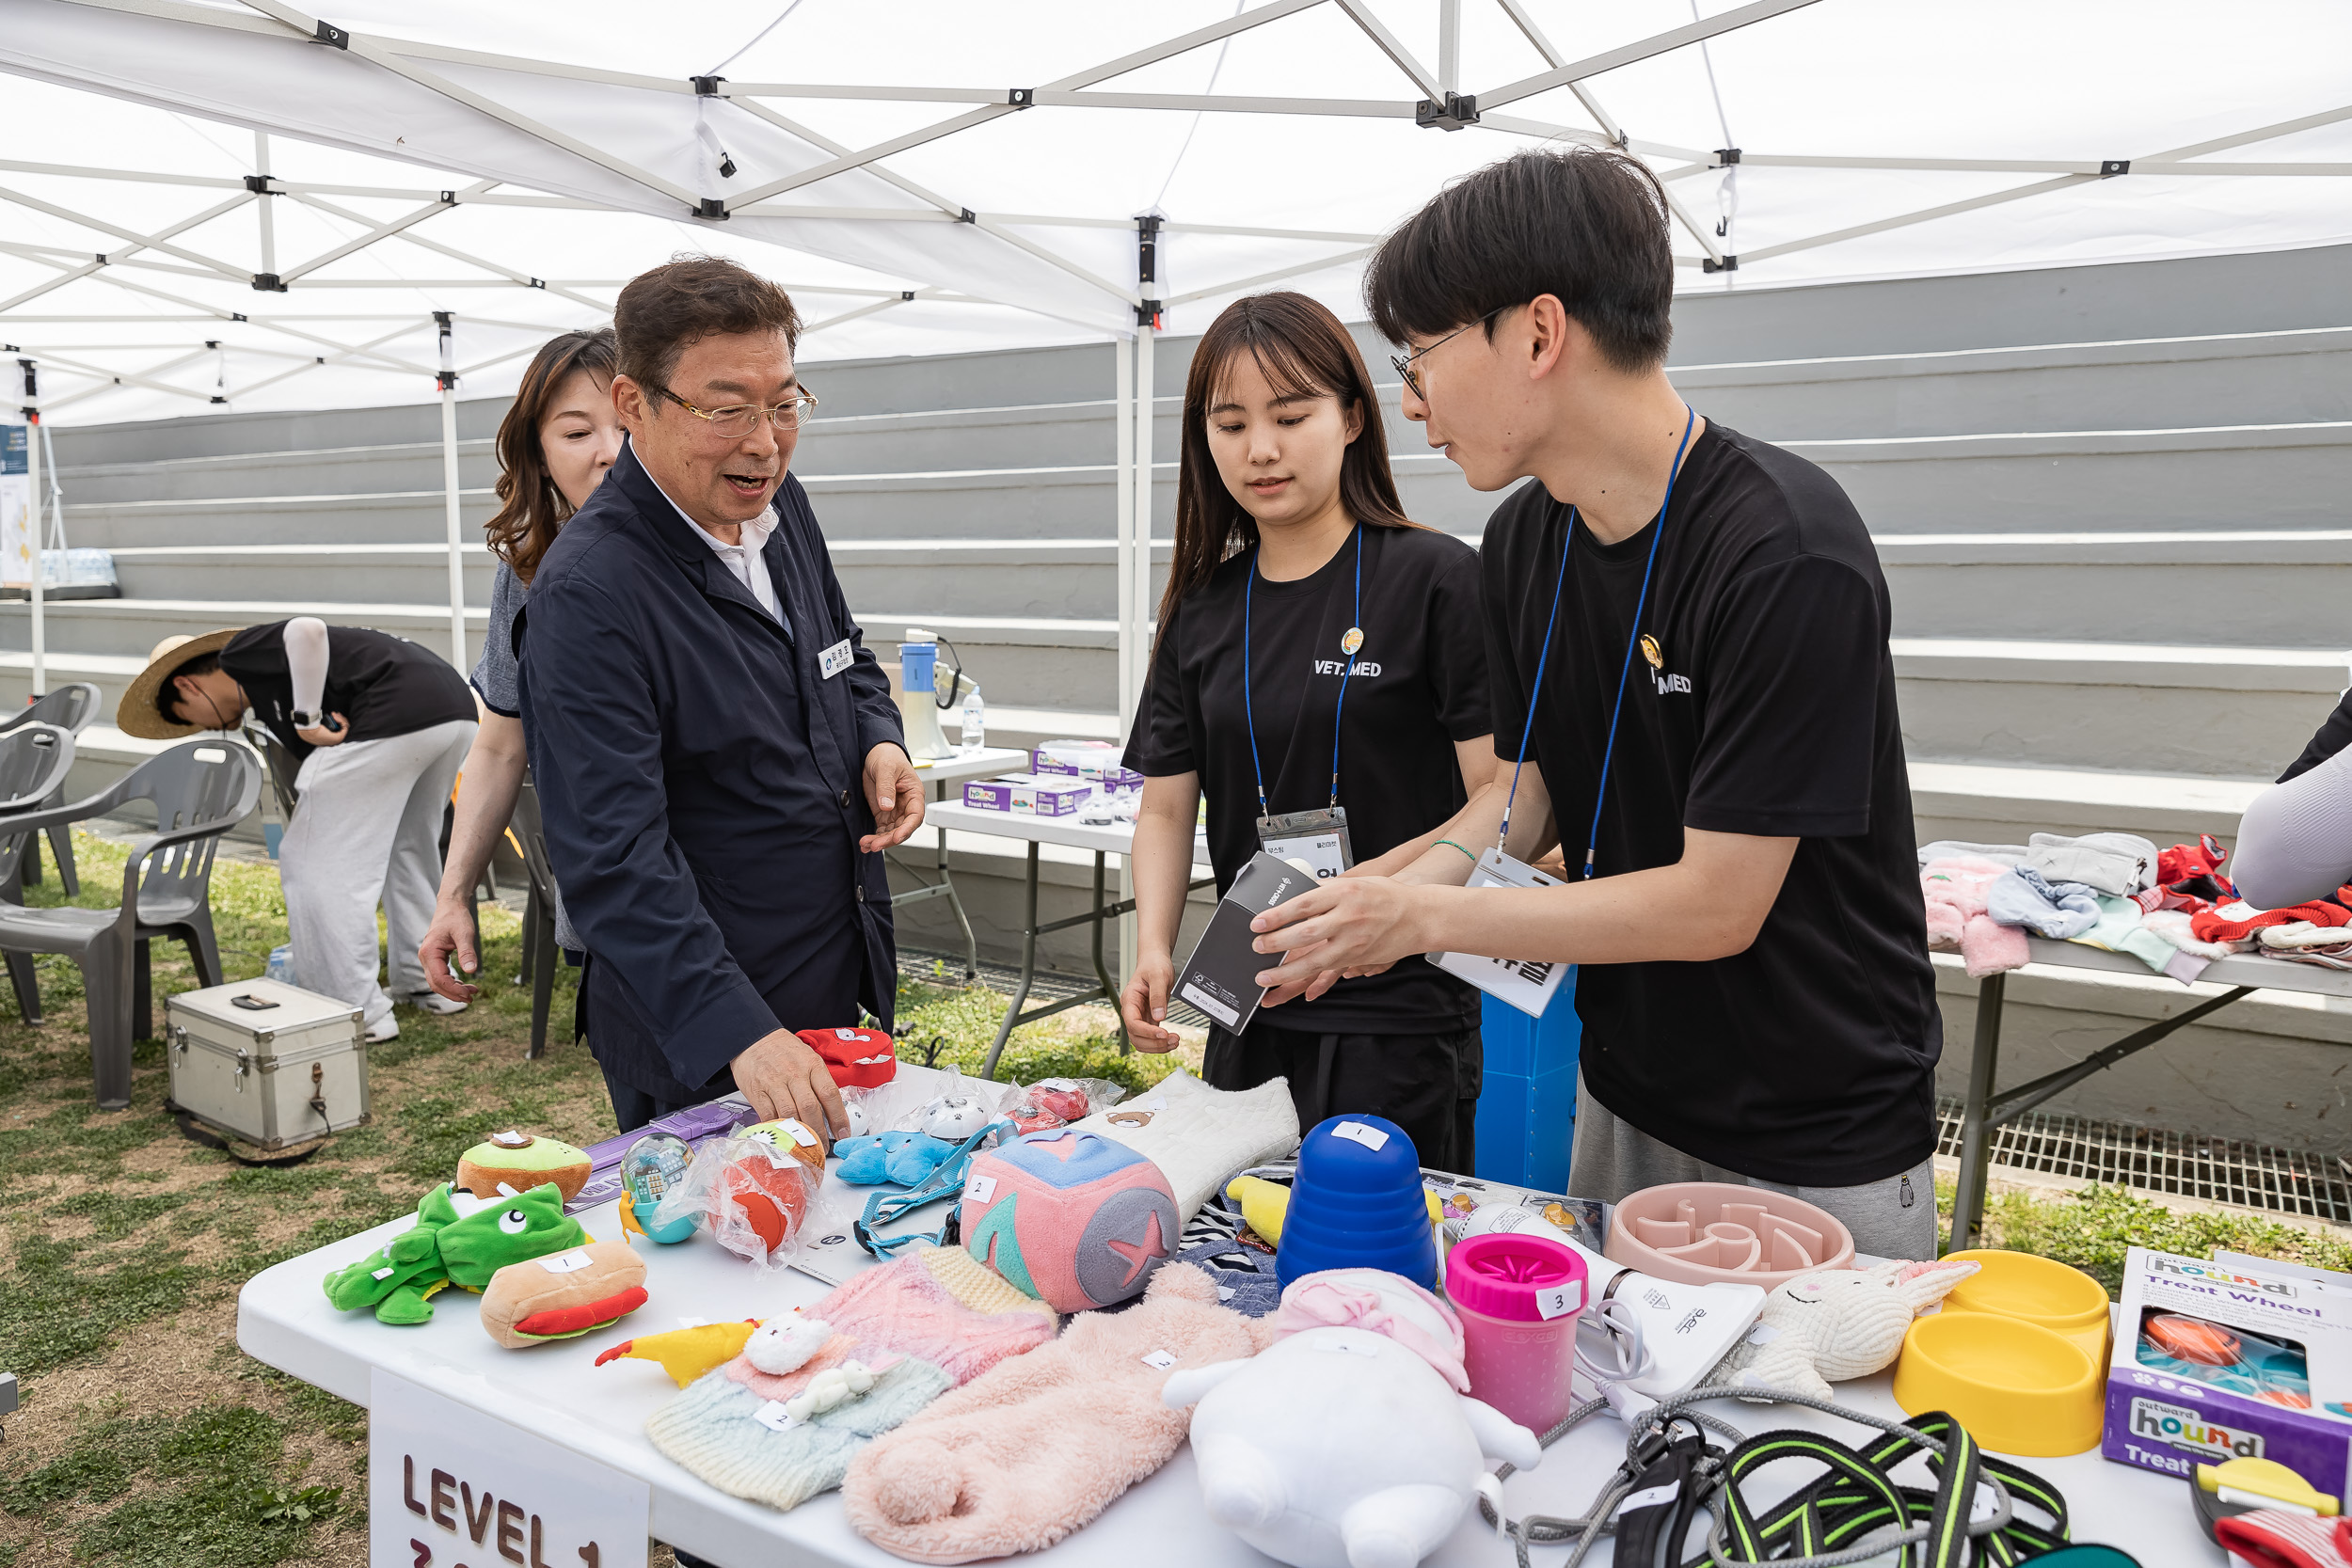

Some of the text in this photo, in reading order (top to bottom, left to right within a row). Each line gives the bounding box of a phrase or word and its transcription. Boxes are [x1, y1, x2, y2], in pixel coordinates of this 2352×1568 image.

[1315, 660, 1382, 677] VET. MED
[1658, 673, 1692, 695] MED
[1267, 892, 1279, 906] CROSS
[975, 1182, 981, 1193] 2
[2155, 1257, 2217, 1271] outward
[2154, 1259, 2292, 1296] hound
[1555, 1294, 1564, 1309] 3
[2144, 1275, 2322, 1318] Treat Wheel
[2138, 1401, 2194, 1419] outward
[776, 1415, 787, 1424] 2
[2137, 1408, 2257, 1457] hound
[2124, 1443, 2191, 1475] Treat
[405, 1454, 553, 1568] LEVEL
